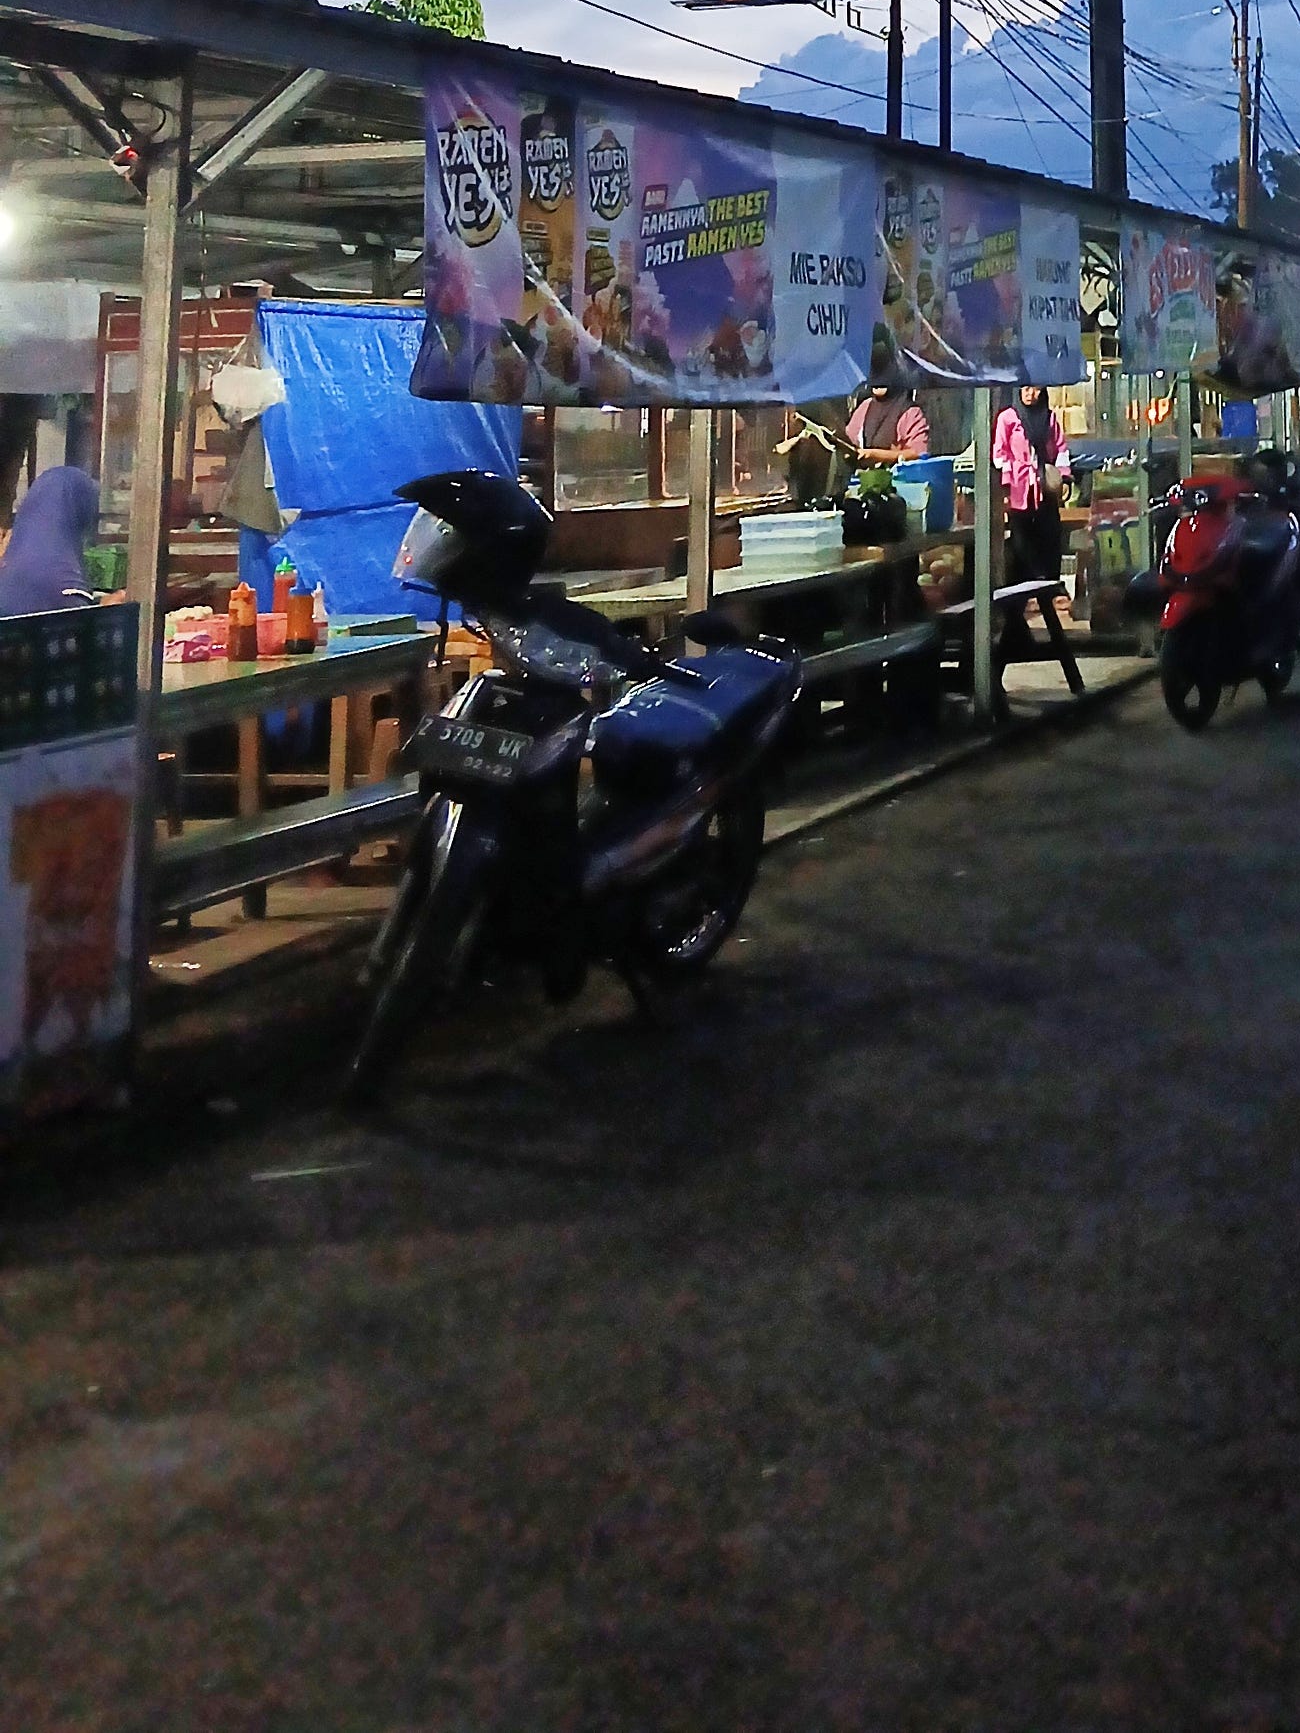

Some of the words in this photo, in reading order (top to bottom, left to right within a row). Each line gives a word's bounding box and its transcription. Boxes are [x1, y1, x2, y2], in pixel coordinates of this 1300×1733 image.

[438, 128, 507, 166] RAMEN
[525, 137, 569, 163] RAMEN
[588, 148, 627, 172] RAMEN
[528, 164, 562, 200] YES
[590, 172, 622, 213] YES
[707, 194, 735, 223] THE
[737, 189, 771, 217] BEST
[645, 239, 686, 267] PASTI
[739, 219, 767, 249] YES
[807, 302, 851, 337] CIHUY
[418, 718, 434, 736] Z
[440, 724, 486, 749] 5709
